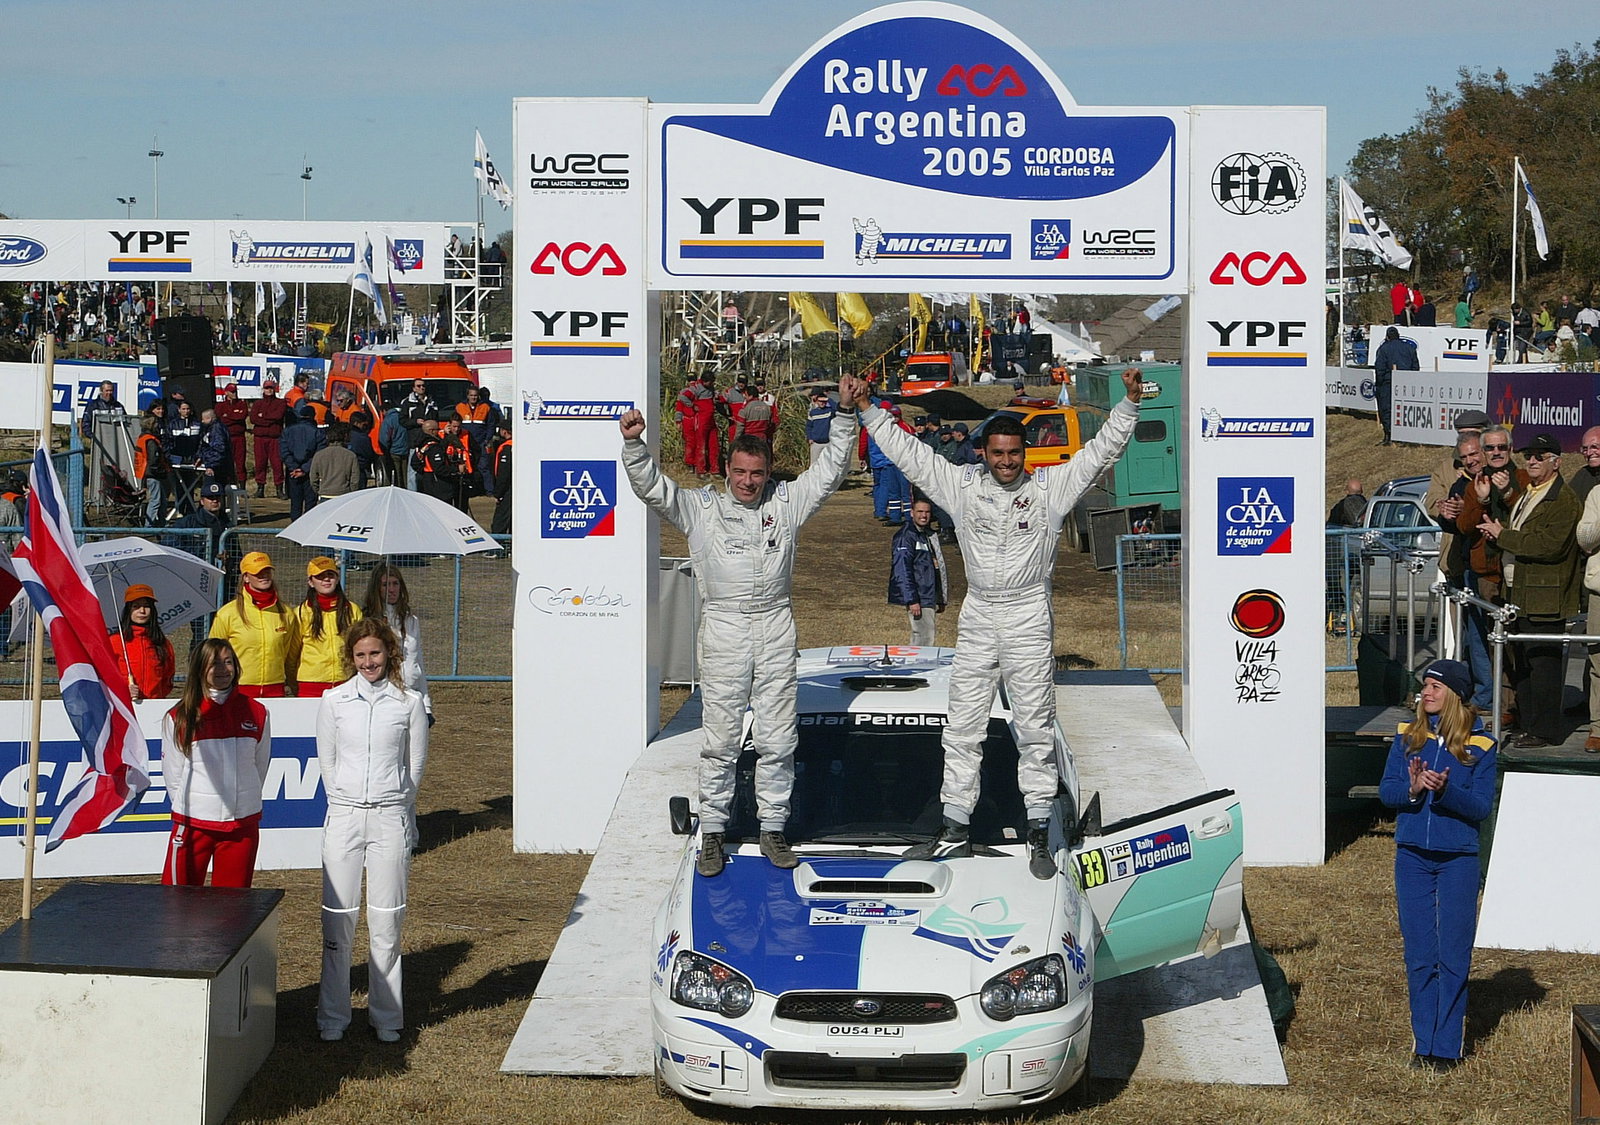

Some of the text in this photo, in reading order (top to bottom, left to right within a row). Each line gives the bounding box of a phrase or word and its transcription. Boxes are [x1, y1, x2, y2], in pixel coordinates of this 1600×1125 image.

[823, 59, 1028, 102] Rally ACA
[824, 104, 1027, 145] Argentina
[531, 153, 629, 174] WRC
[922, 147, 1115, 176] 2005 CORDOBA
[1024, 165, 1115, 176] Villa Carlos Paz
[680, 197, 825, 235] YPF
[1042, 224, 1060, 234] LA
[1083, 229, 1155, 244] WRC
[108, 231, 190, 253] YPF
[885, 238, 1007, 253] MICHELIN
[1034, 233, 1067, 246] CAJA
[256, 246, 352, 258] MICHELIN
[530, 241, 627, 276] ACA
[1209, 251, 1307, 286] ACA
[531, 310, 629, 337] YPF
[1206, 321, 1307, 347] YPF
[1445, 338, 1478, 351] YPF
[1394, 385, 1434, 398] GRUPO
[1440, 387, 1483, 400] GRUPO
[545, 405, 630, 415] MICHELIN
[1402, 406, 1433, 429] ECIPSA
[1520, 397, 1583, 427] Multicanal
[1224, 422, 1310, 432] MICHELIN
[563, 470, 597, 489] LA
[548, 488, 609, 511] CAJA
[1240, 487, 1274, 505] LA
[549, 509, 595, 519] de ahorro
[1225, 505, 1286, 528] CAJA
[335, 522, 374, 535] YPF
[454, 525, 477, 537] YPF
[549, 520, 587, 531] y seguro
[1226, 526, 1272, 537] de ahorro
[1226, 537, 1264, 548] y seguro
[104, 547, 143, 557] ECCO
[1235, 640, 1281, 663] VILLA
[1234, 663, 1281, 689] CARLOS
[1235, 686, 1282, 704] PAZ
[1108, 843, 1129, 856] YPF
[1136, 837, 1154, 851] Rally
[1135, 840, 1190, 869] Argentina
[1081, 850, 1105, 888] 33
[830, 1026, 900, 1036] OU54 PLJ
